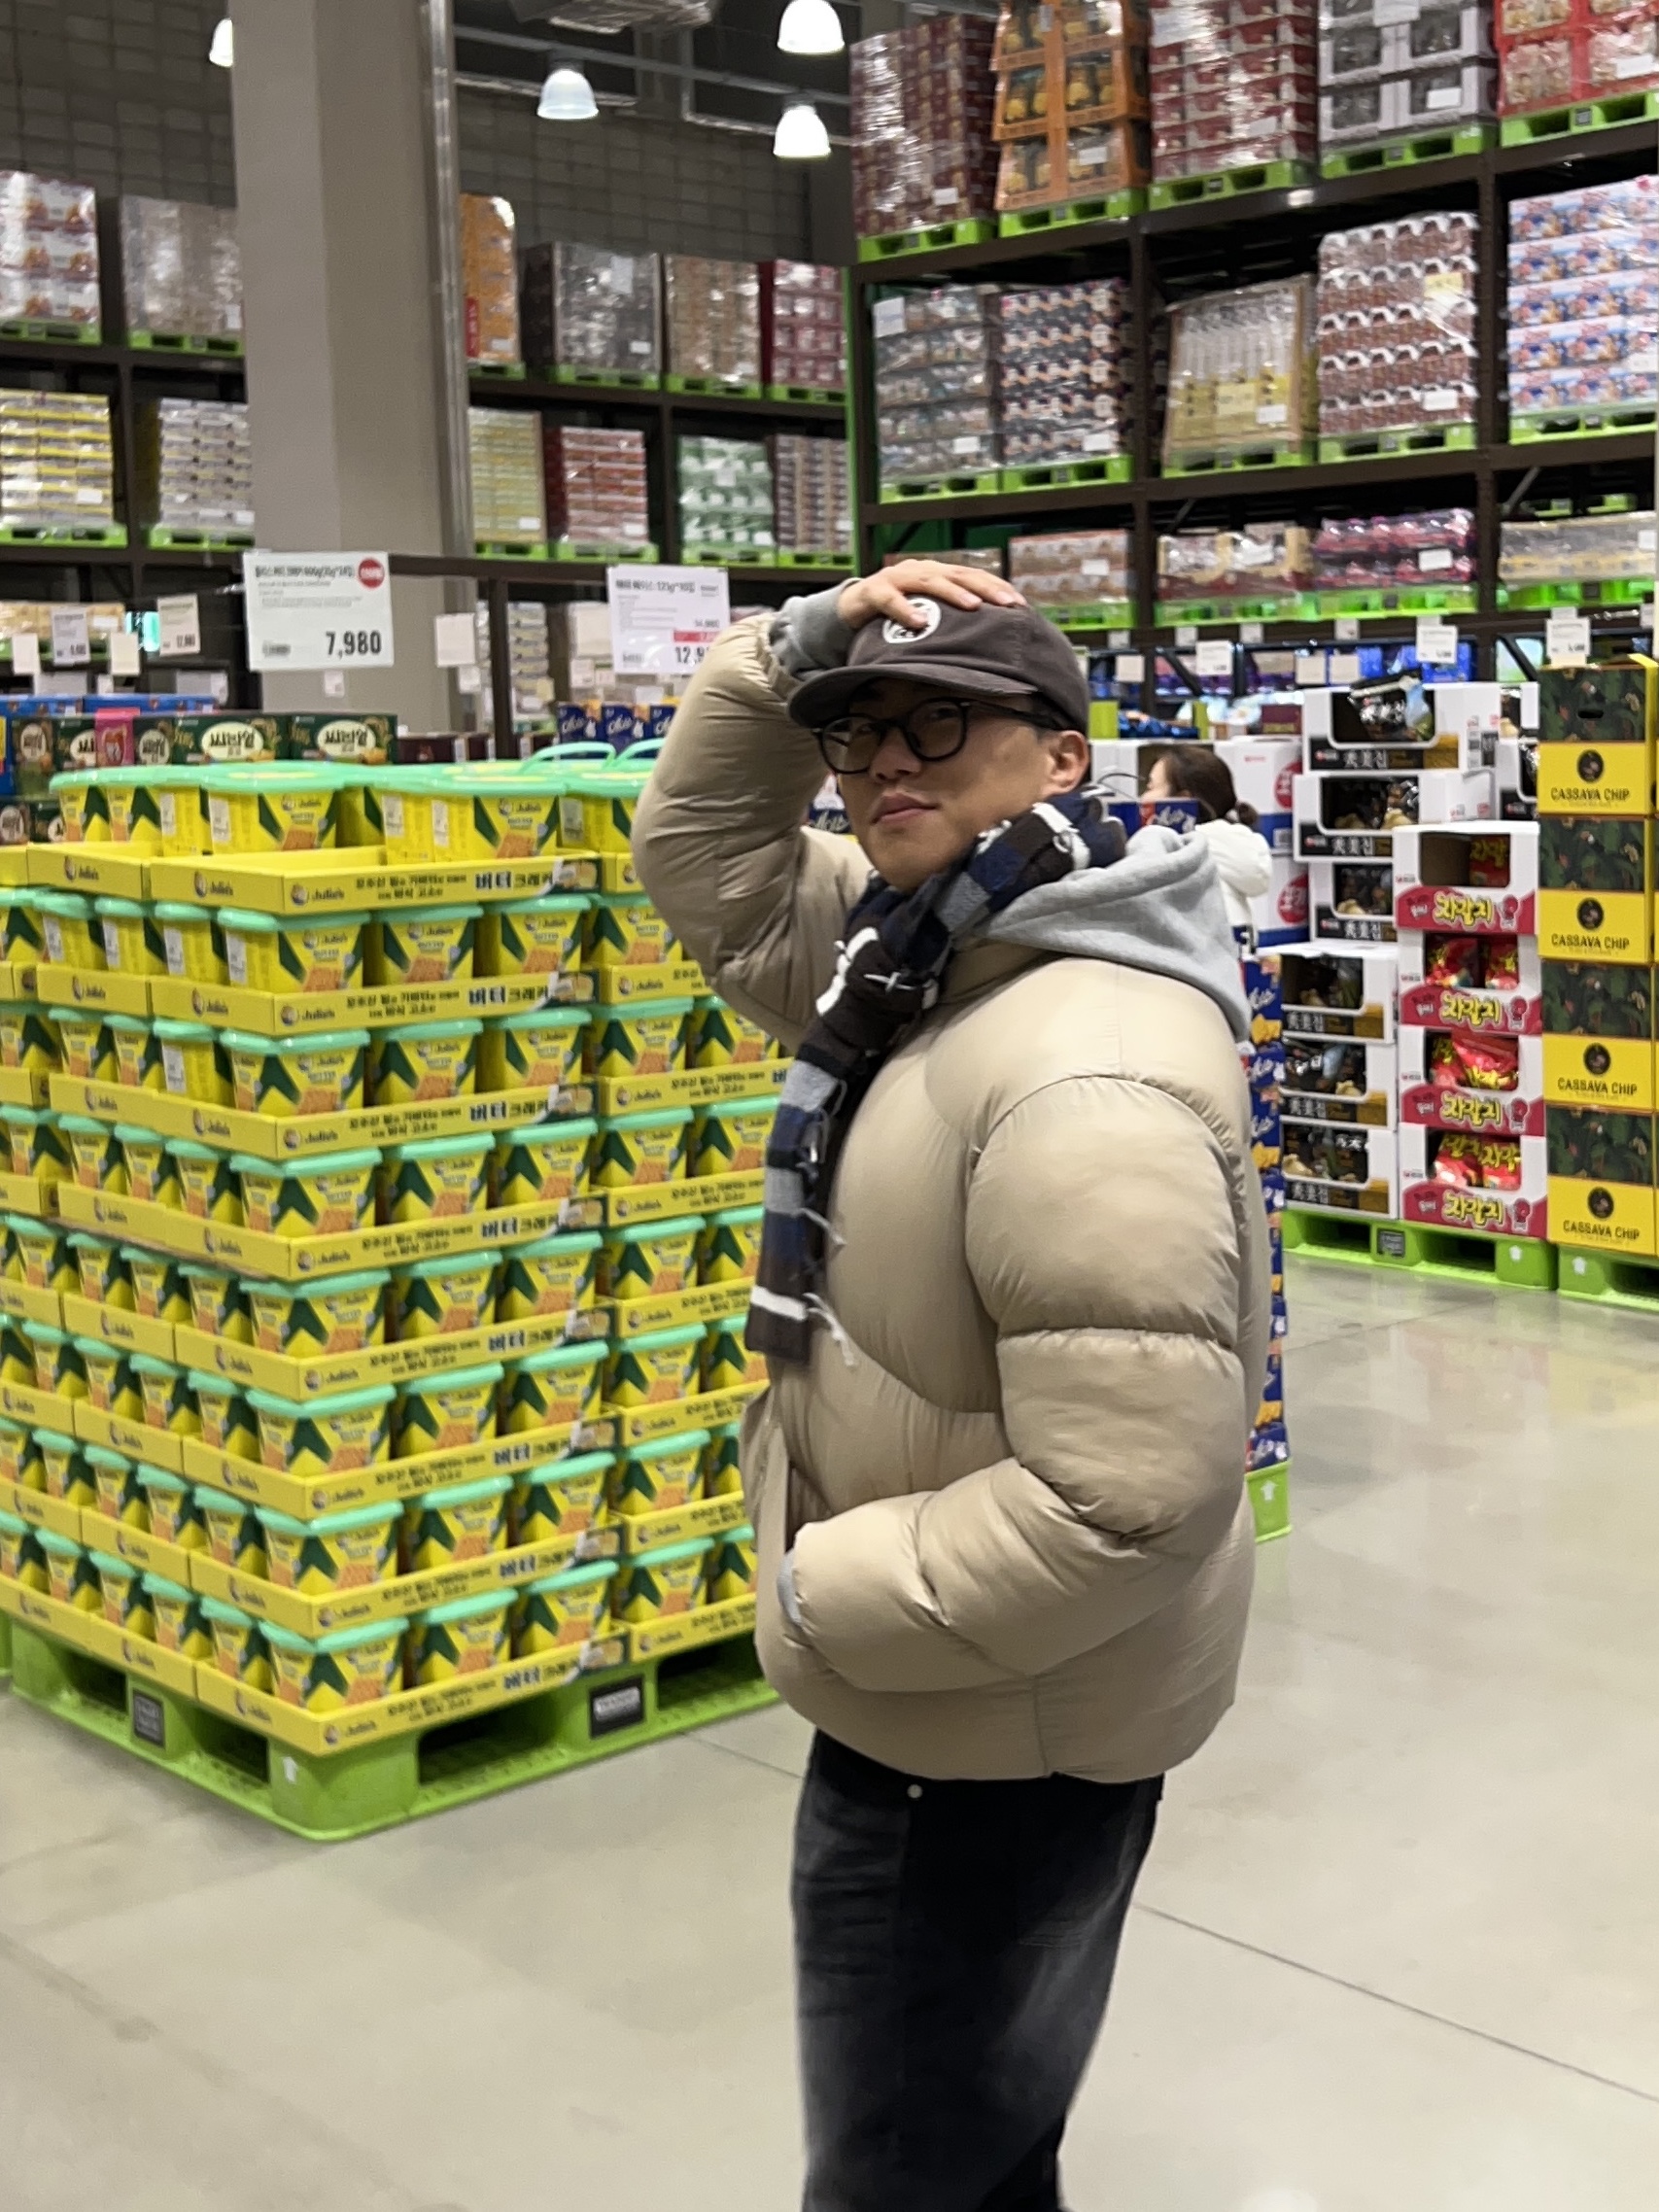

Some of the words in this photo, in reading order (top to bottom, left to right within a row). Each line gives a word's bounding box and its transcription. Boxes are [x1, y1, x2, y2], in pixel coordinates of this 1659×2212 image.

[326, 631, 382, 660] 7,980
[1551, 787, 1601, 800] CASSAVA
[1604, 788, 1630, 801] CHIP
[1551, 933, 1601, 949] CASSAVA
[1605, 936, 1630, 950] CHIP
[1558, 1078, 1607, 1093] CASSAVA
[1611, 1082, 1638, 1095] CHIP
[1563, 1220, 1611, 1237] CASSAVA
[1615, 1227, 1640, 1240] CHIP
